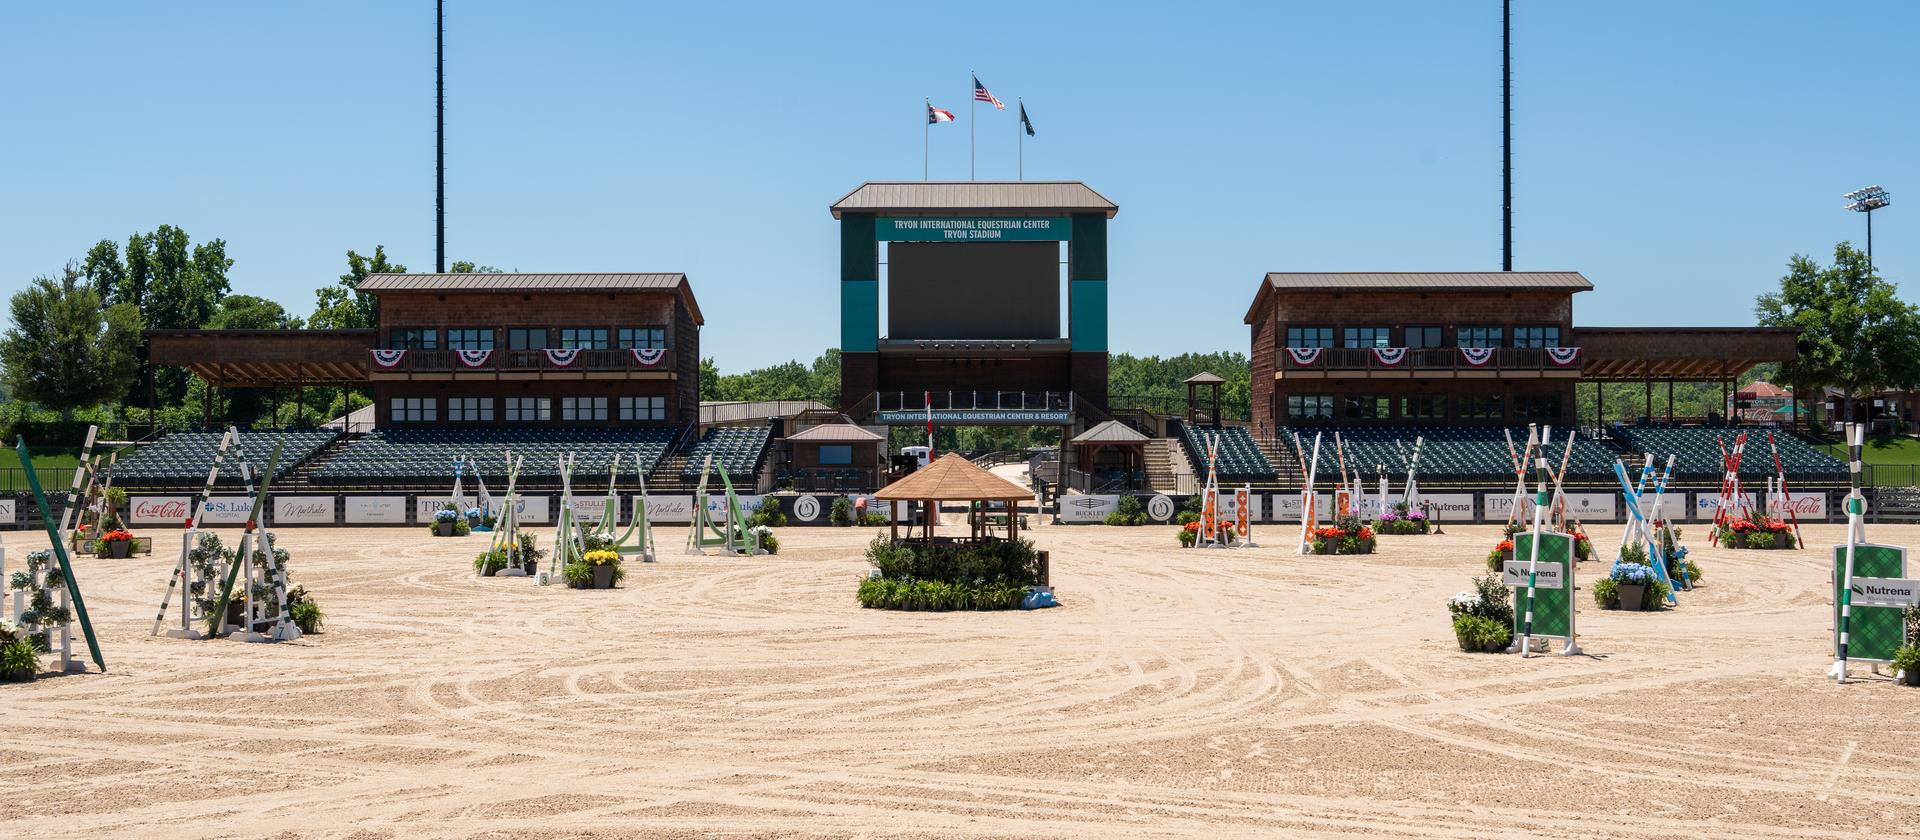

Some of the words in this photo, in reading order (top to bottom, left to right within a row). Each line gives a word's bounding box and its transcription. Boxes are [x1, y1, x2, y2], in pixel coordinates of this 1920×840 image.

[895, 220, 918, 229] TRYON
[920, 220, 975, 229] INTERNATIONAL
[977, 220, 1022, 230] EQUESTRIAN
[1023, 220, 1050, 229] CENTER
[944, 230, 967, 239] TRYON
[969, 230, 1001, 239] STADIUM
[962, 413, 1006, 421] EQUESTRIAN
[215, 502, 228, 512] St.
[1430, 502, 1470, 511] Nutrena
[1866, 585, 1911, 596] Nutrena
[278, 626, 284, 638] 7
